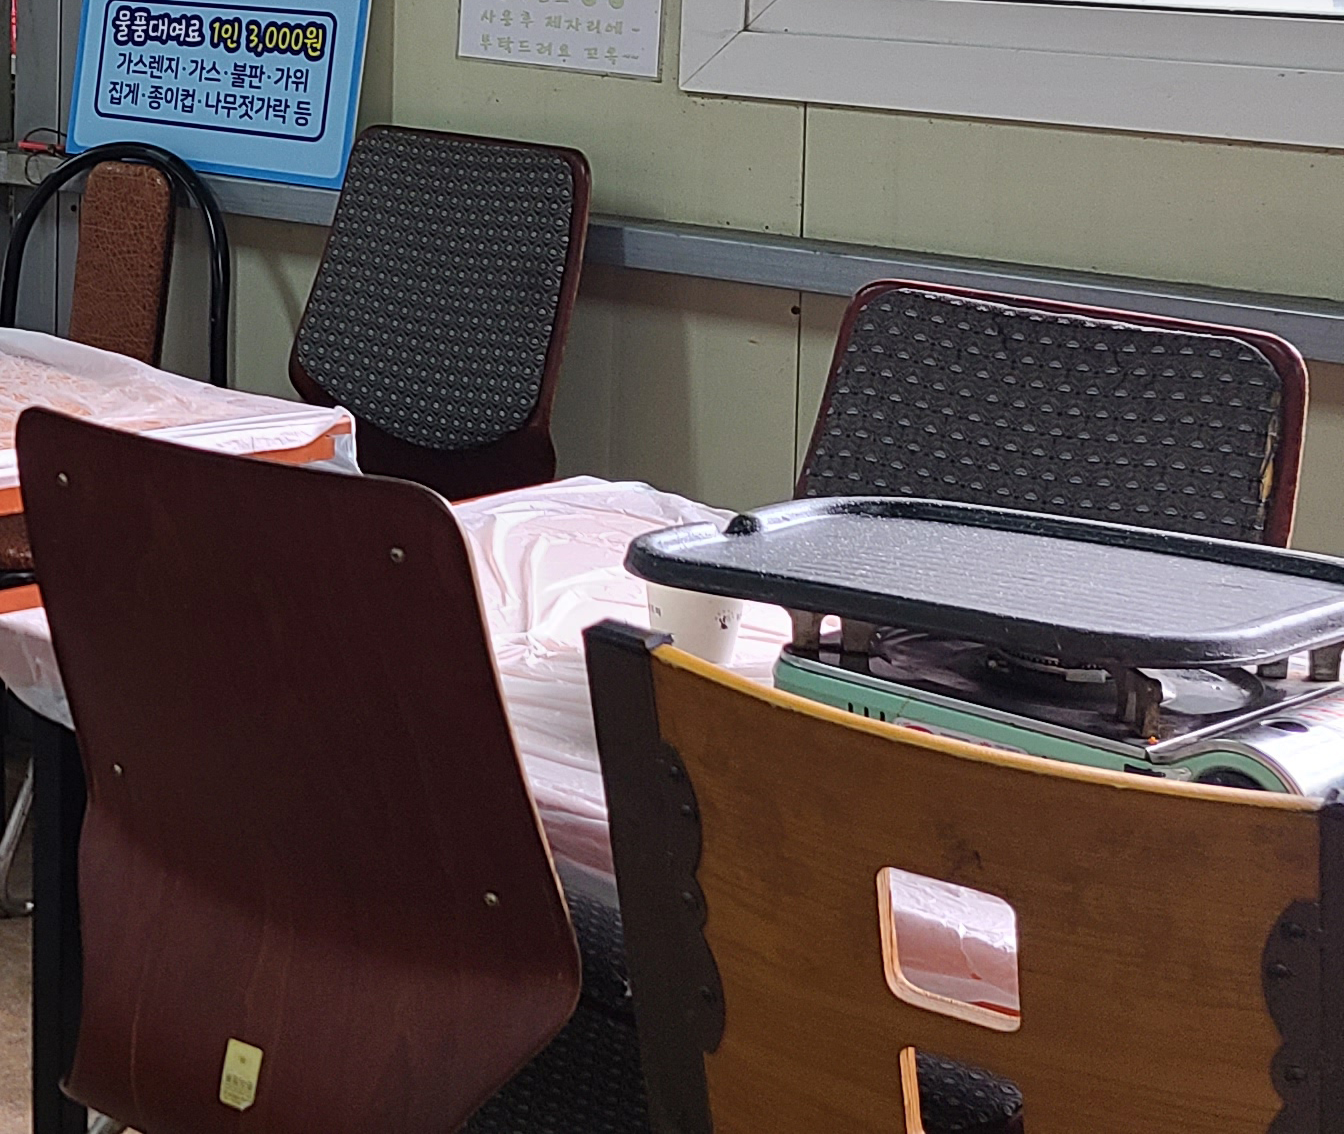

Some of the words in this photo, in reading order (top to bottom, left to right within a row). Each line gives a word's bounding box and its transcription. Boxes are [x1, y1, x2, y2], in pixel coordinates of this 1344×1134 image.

[115, 6, 203, 43] 물품대여료
[211, 21, 241, 48] 1인
[247, 24, 324, 57] 3,000원
[293, 101, 312, 127] 등
